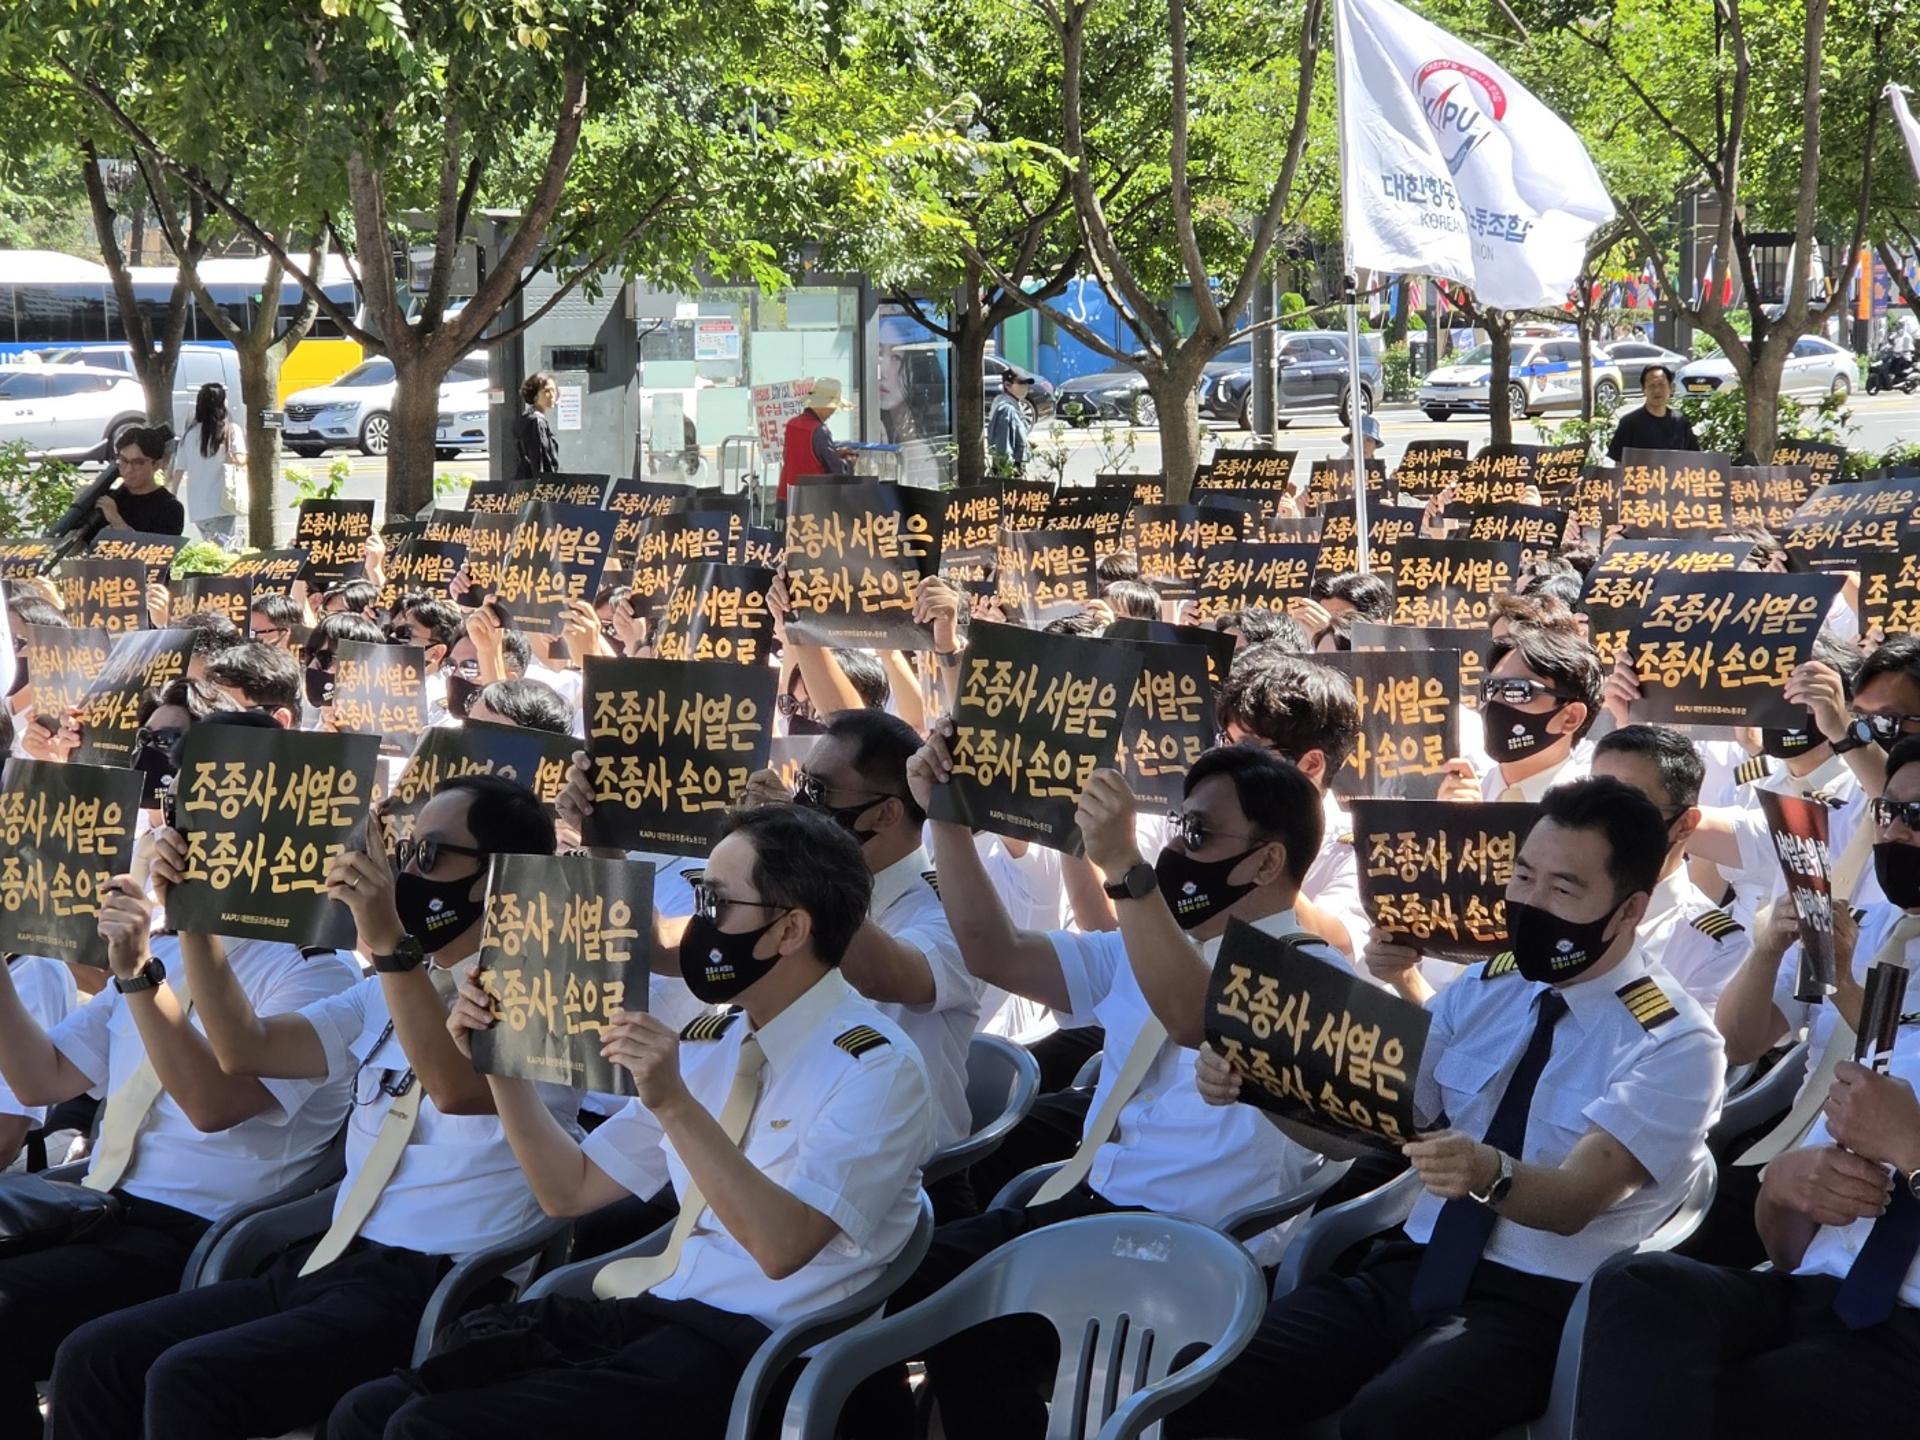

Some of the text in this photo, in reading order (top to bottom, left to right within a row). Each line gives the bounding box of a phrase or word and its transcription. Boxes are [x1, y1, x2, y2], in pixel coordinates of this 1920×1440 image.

[1213, 457, 1290, 477] 조종사 서열은
[1341, 471, 1384, 490] 서은
[1491, 454, 1532, 478] 서열은
[1621, 465, 1726, 498] 조종사 서열은
[564, 483, 601, 506] 서열은
[610, 492, 651, 517] 조종사
[1763, 478, 1809, 503] 서열은
[1856, 489, 1914, 516] 서열은
[299, 512, 370, 537] 조종사 서열은
[961, 496, 1001, 523] 서열은
[1619, 499, 1728, 530] 조종사 손으로
[539, 521, 602, 566] 서열은
[615, 519, 642, 543] 종사
[671, 527, 724, 559] 서열은
[787, 511, 845, 560] 조종사
[850, 511, 934, 558] 서열은
[1138, 519, 1238, 550] 조종사 서열은
[1470, 514, 1559, 547] 조종사 서열은
[1784, 520, 1900, 551] 조종사 손으로
[412, 554, 457, 582] 서열은
[1030, 544, 1091, 578] 서열은
[1200, 557, 1309, 591] 조종사 서열은
[1367, 551, 1395, 574] 손으
[1396, 556, 1513, 593] 조종사 서열은
[1597, 551, 1736, 574] 조종사 서열은
[88, 576, 141, 609] 서열은
[534, 567, 589, 604] 손으로
[787, 567, 854, 614] 조종사
[857, 568, 922, 614] 손으로
[1033, 580, 1089, 610] 손으로
[1585, 577, 1654, 608] 조종사
[701, 585, 768, 629] 서열은
[1393, 596, 1489, 630] 조종사 손으
[1642, 591, 1819, 637] 조종사 서열은
[337, 660, 422, 697] 조종사 서열은
[1635, 640, 1799, 690] 조종사 손으로
[960, 658, 1118, 739] 조종사 서열은
[1128, 670, 1205, 723] 서열은
[1372, 675, 1450, 727] 서열은
[590, 689, 762, 752] 조종사 서열은
[951, 727, 1023, 795] 조종사
[1374, 731, 1448, 778] 손으로
[184, 760, 362, 828] 조종사 서열은
[400, 753, 440, 805] 종사
[593, 754, 671, 814] 조종사
[51, 795, 127, 856] 서열은
[180, 831, 268, 894] 조종사
[1367, 830, 1517, 886] 조종사 서열
[484, 890, 639, 963] 조종사 서열은
[1376, 892, 1459, 942] 조종사
[480, 969, 559, 1035] 조종사
[1216, 963, 1410, 1103] 조종사 서열은
[1217, 1036, 1315, 1115] 조종사
